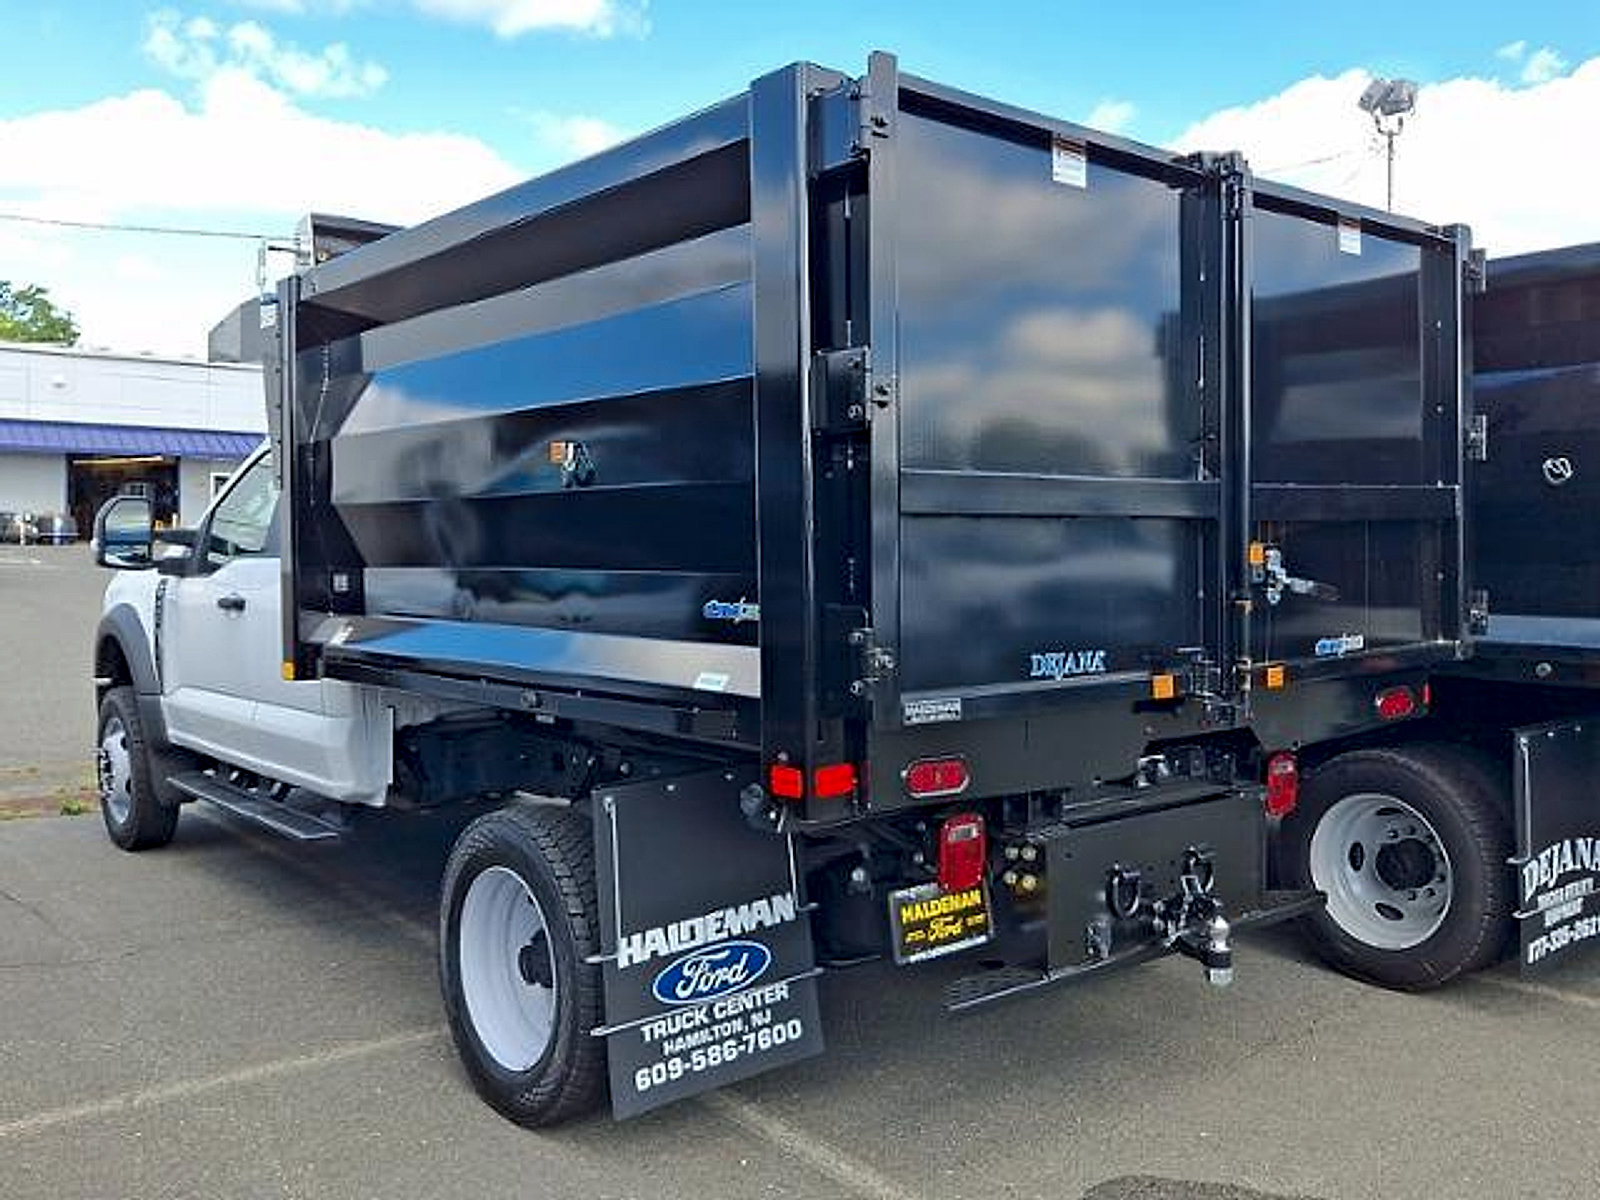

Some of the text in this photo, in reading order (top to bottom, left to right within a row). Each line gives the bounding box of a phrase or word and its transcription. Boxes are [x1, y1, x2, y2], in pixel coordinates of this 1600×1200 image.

[1030, 650, 1106, 681] DEJANA
[617, 892, 797, 969] HALDEMAN
[675, 949, 749, 999] Ford
[640, 984, 790, 1042] TRUCK CENTER
[663, 1009, 772, 1056] HAMILTON, NJ
[635, 1019, 802, 1092] 609-586-7600
